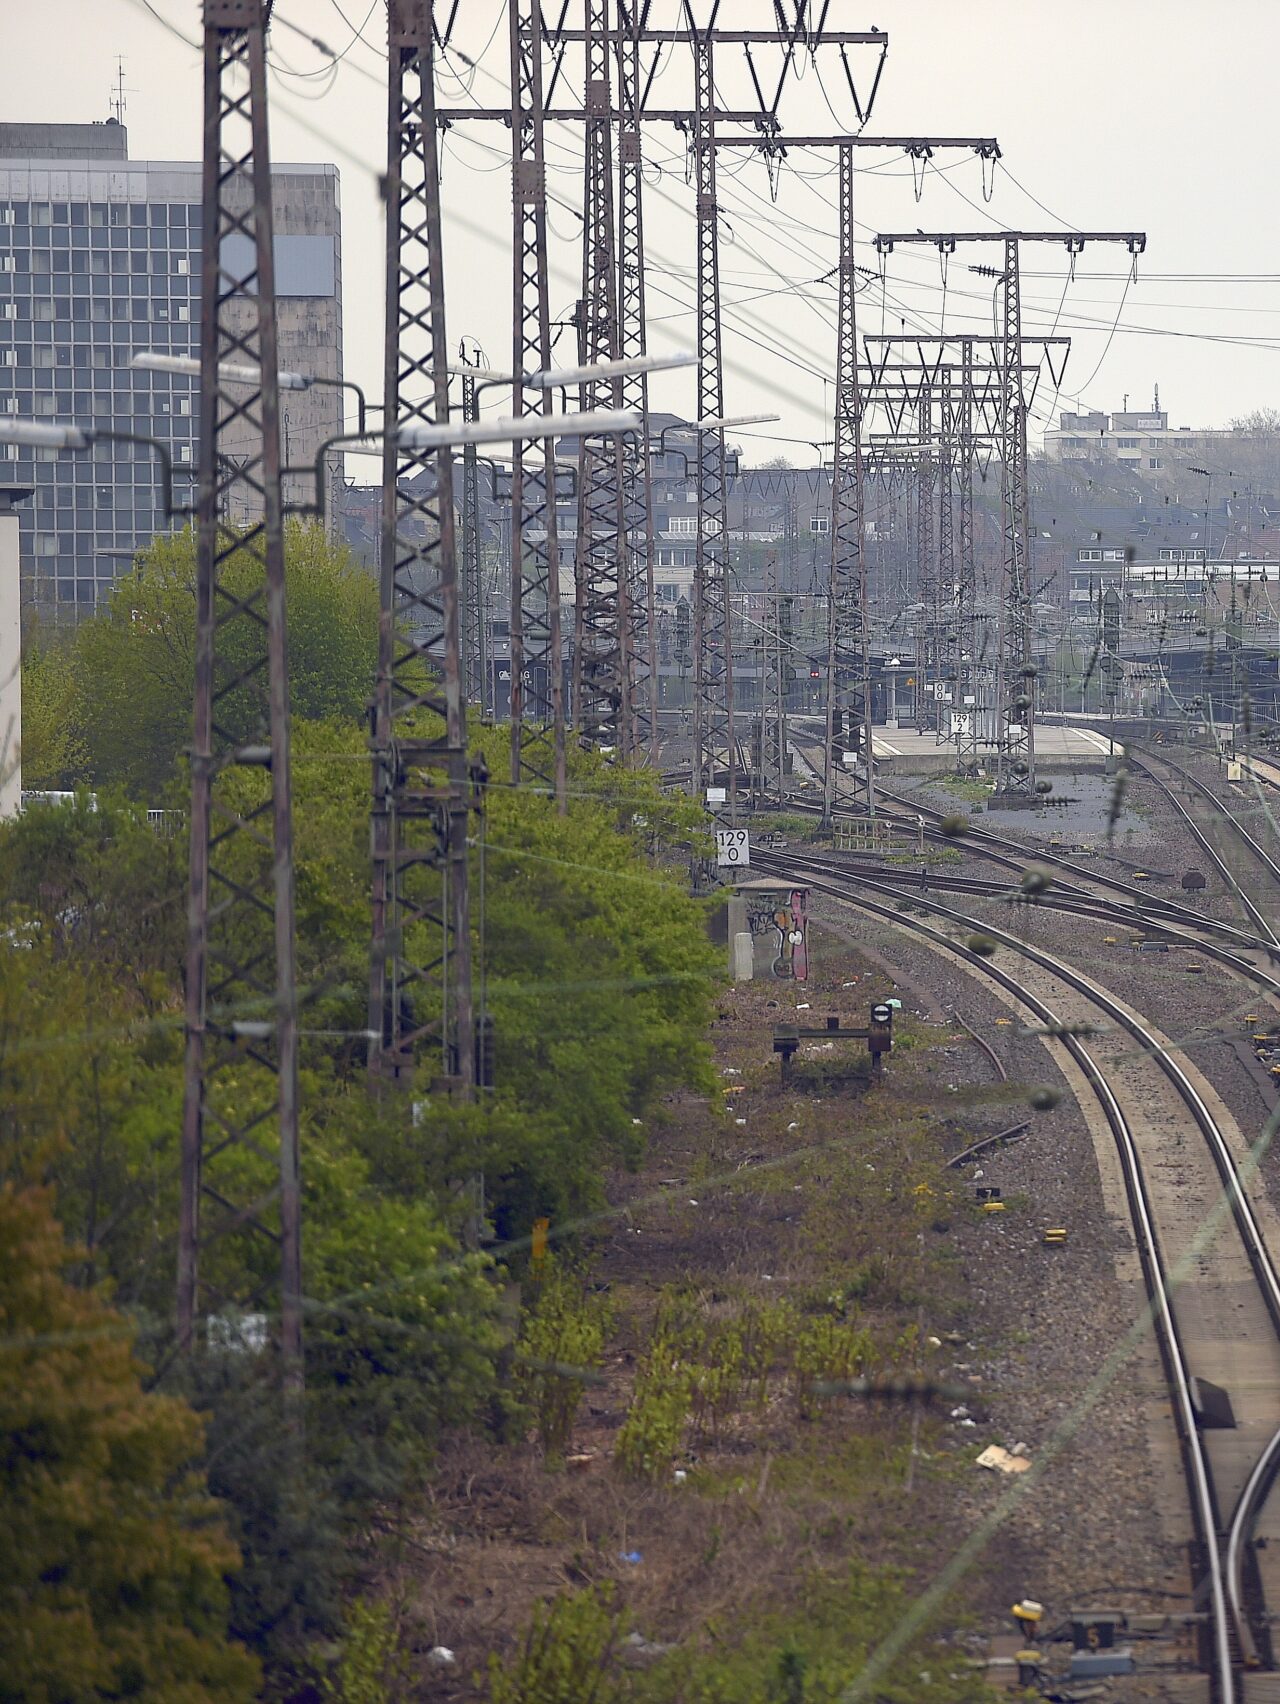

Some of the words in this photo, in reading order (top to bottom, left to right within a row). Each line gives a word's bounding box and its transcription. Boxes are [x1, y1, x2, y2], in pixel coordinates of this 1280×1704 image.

[936, 683, 943, 692] 0
[936, 692, 943, 700] 0
[953, 714, 968, 723] 129
[957, 723, 963, 732] 2
[719, 831, 746, 847] 129
[728, 847, 739, 862] 0
